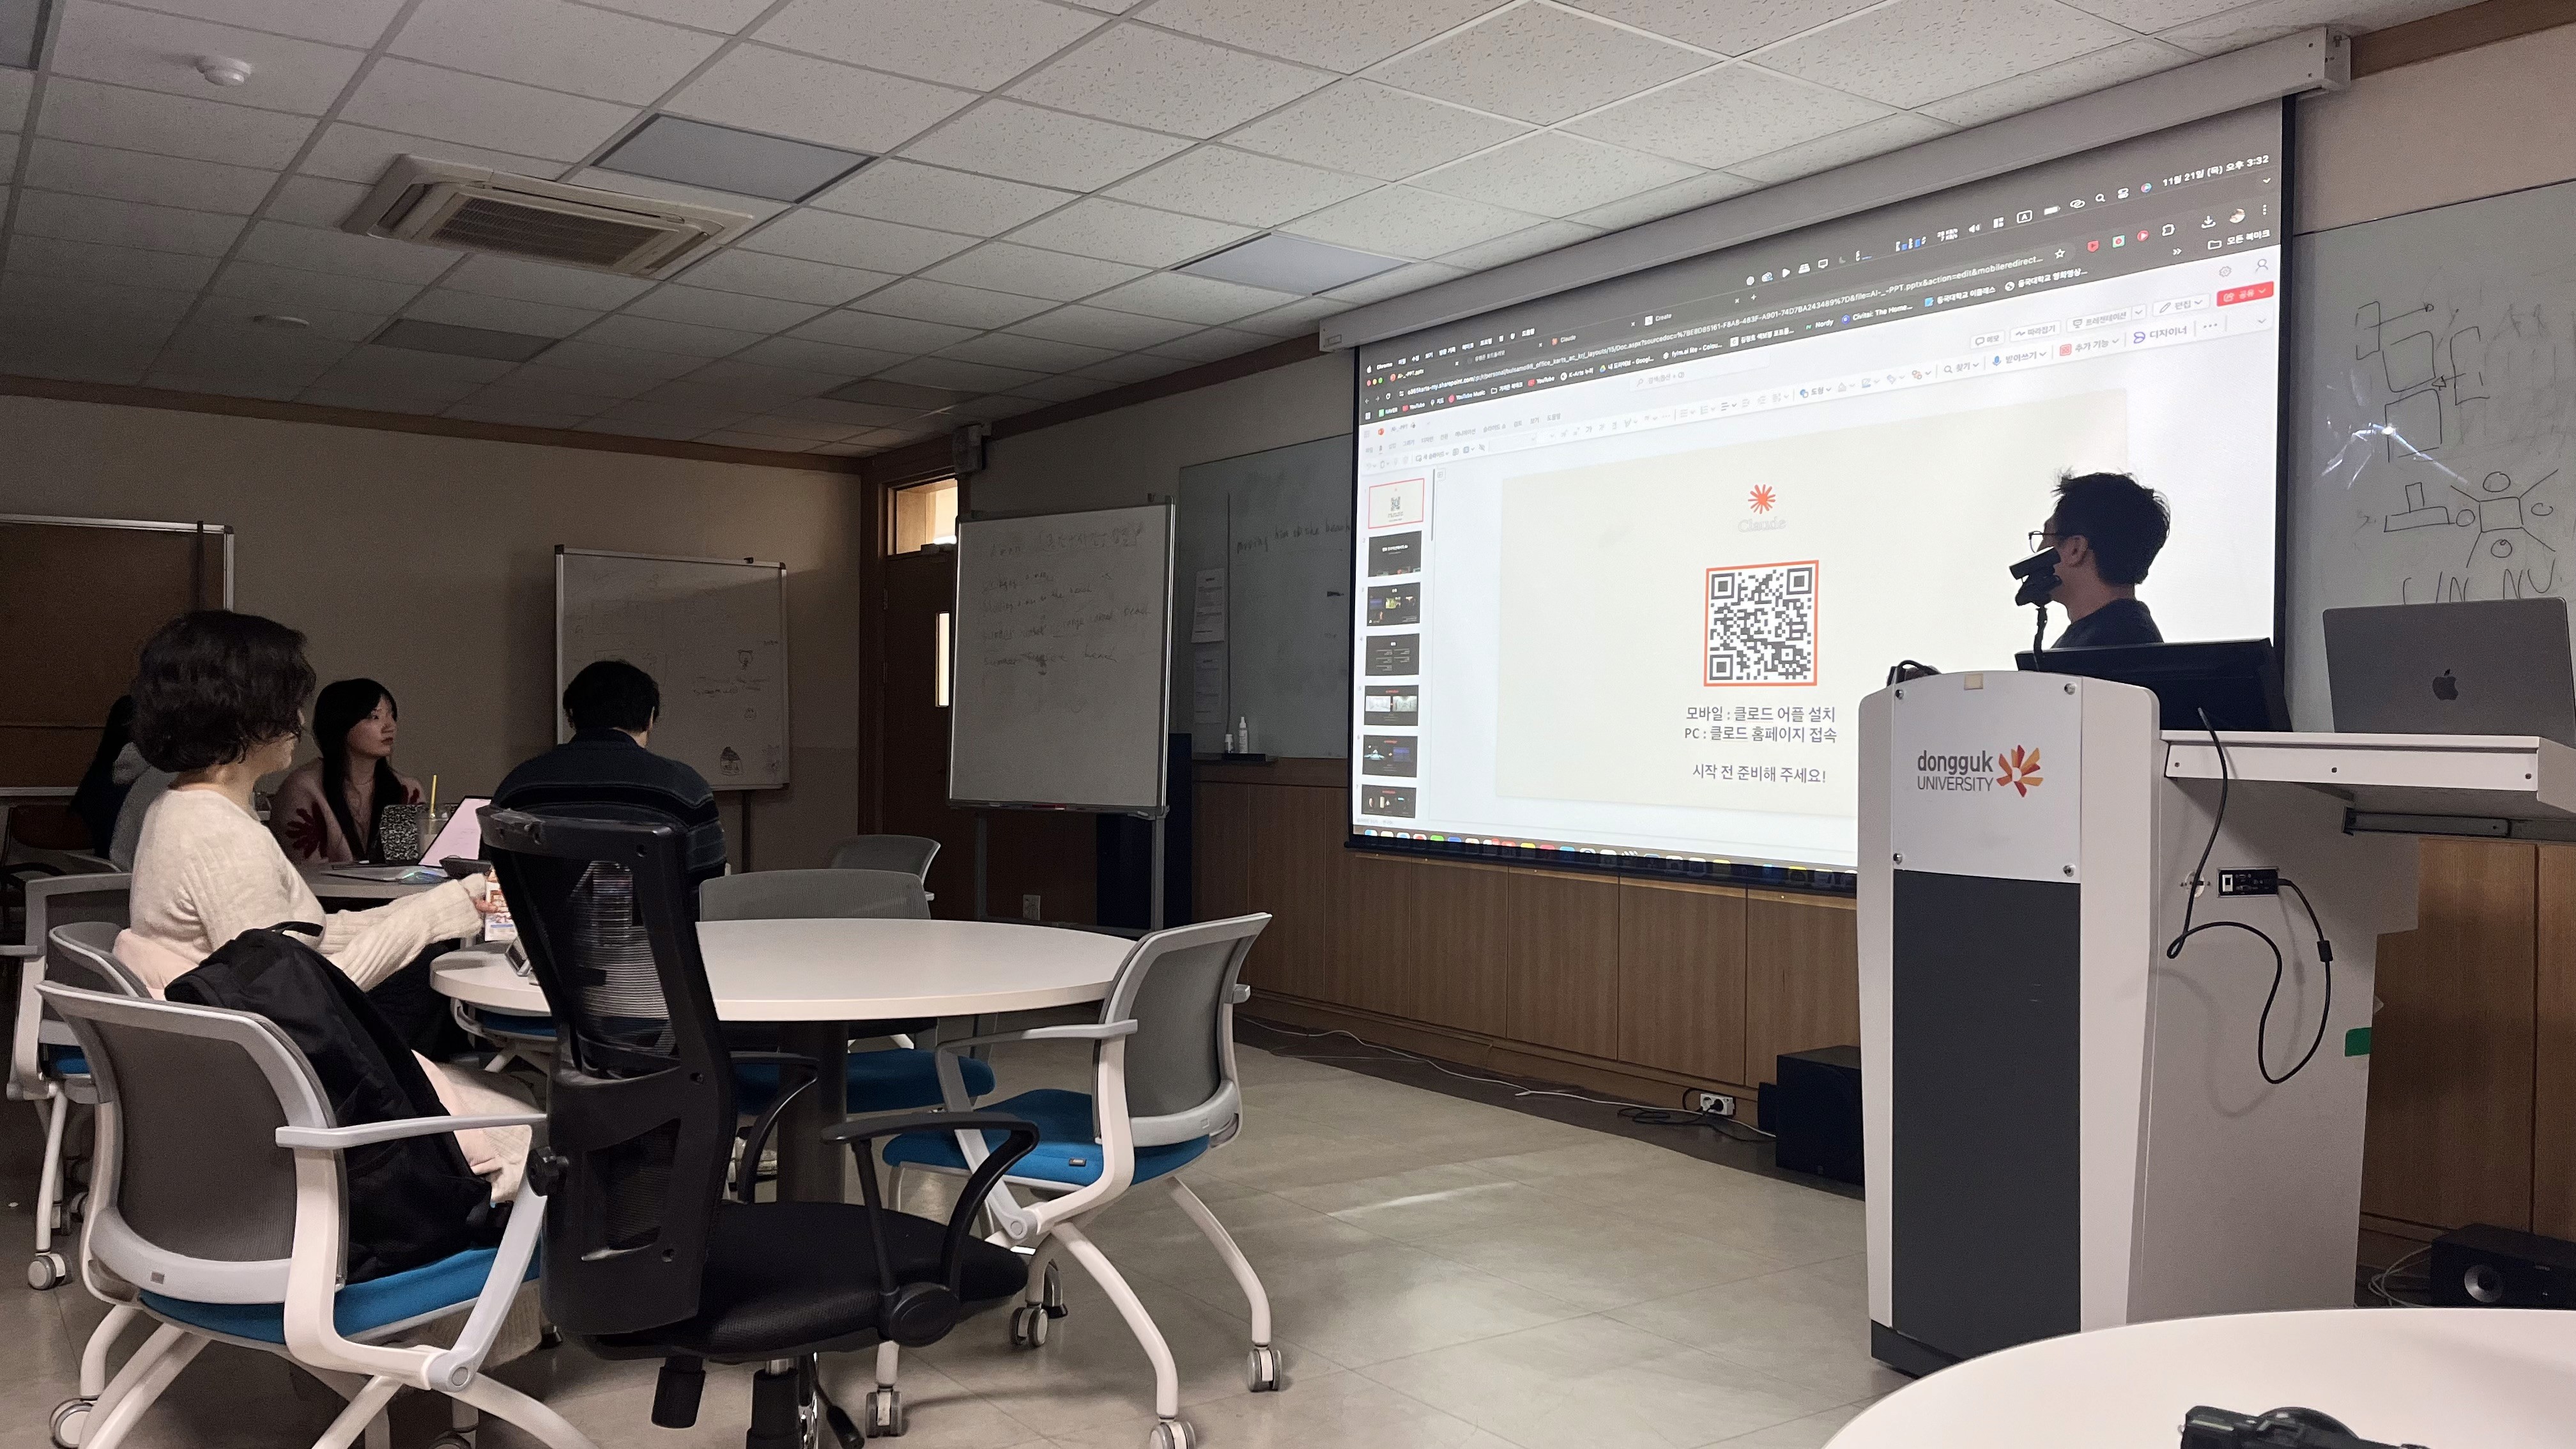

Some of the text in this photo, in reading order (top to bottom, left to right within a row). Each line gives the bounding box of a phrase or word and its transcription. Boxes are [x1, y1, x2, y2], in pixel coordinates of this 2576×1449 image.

[2225, 160, 2244, 172] 오후
[2246, 155, 2269, 167] 3:32
[2227, 229, 2270, 245] 모든 북마크
[1875, 307, 1887, 316] The
[2175, 300, 2191, 310] 편집
[1655, 314, 1672, 322] Create
[1815, 319, 1834, 328] Nordy
[2027, 325, 2055, 337] 따라잡기
[1560, 335, 1576, 343] Claude
[2075, 339, 2109, 352] 추가 기능
[1956, 362, 1970, 372] 찾기
[1536, 376, 1555, 384] YouTube
[1738, 516, 1787, 533] Claude
[1686, 706, 1723, 721] 모바일
[1734, 706, 1774, 721] 클로드
[1777, 707, 1805, 723] 어플
[1809, 706, 1836, 723] 설치
[1685, 728, 1700, 739] PC
[1710, 726, 1748, 741] 클로드
[1751, 726, 1805, 742] 홈페이지
[1809, 727, 1837, 743] 접속
[1917, 750, 1994, 775] dongguk
[1693, 763, 1827, 783] 시작 전 준비해 주세요!
[1917, 776, 1994, 792] UNIVERSITY
